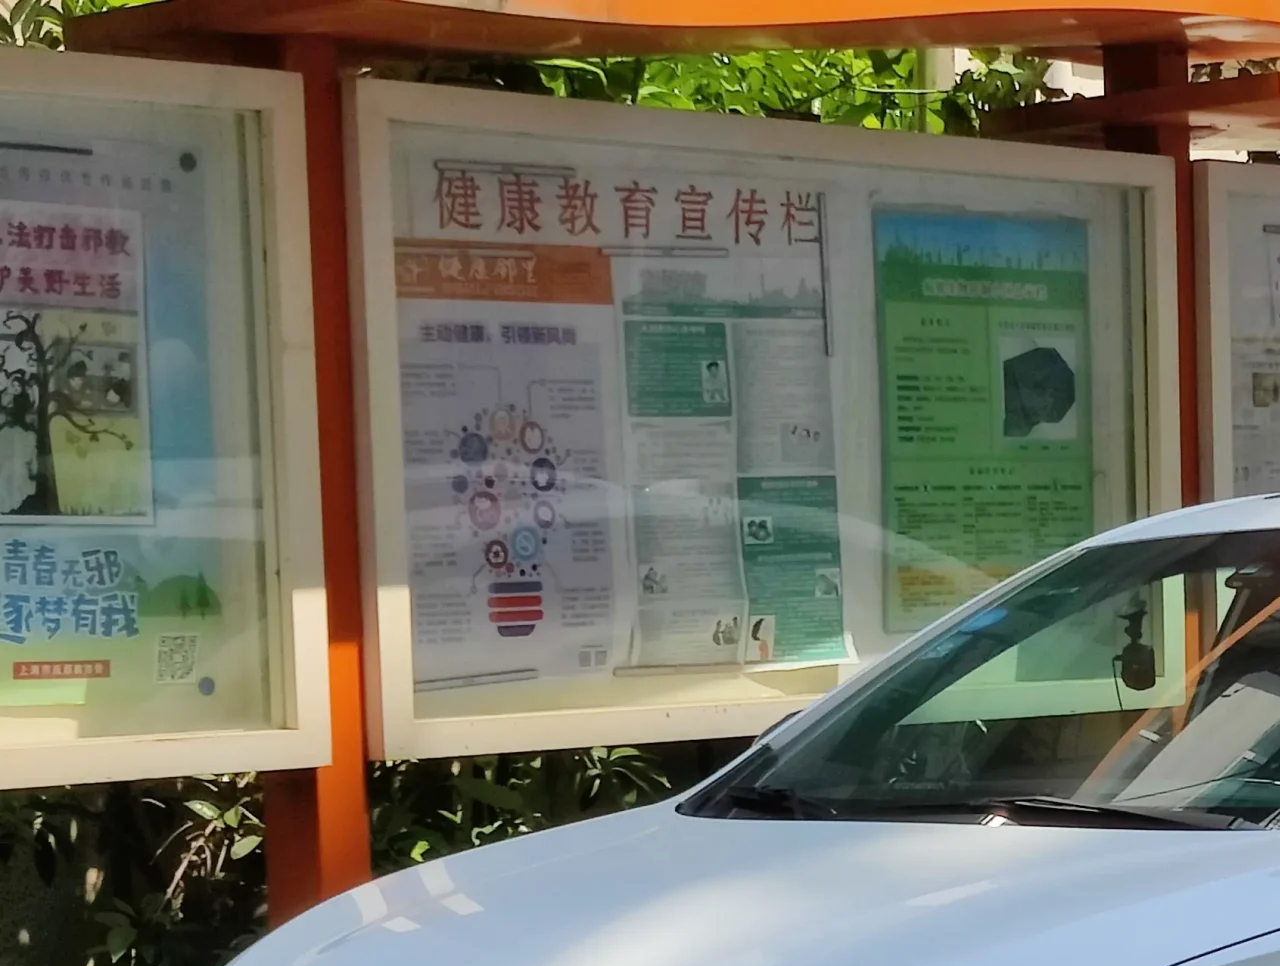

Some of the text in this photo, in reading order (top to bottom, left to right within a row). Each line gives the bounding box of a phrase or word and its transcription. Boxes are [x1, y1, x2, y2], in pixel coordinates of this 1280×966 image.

[435, 168, 822, 247] 健康教育宣传栏
[0, 221, 131, 256] 法打击邪教
[2, 539, 122, 586] 青春无邪
[0, 594, 140, 644] 逐梦有我
